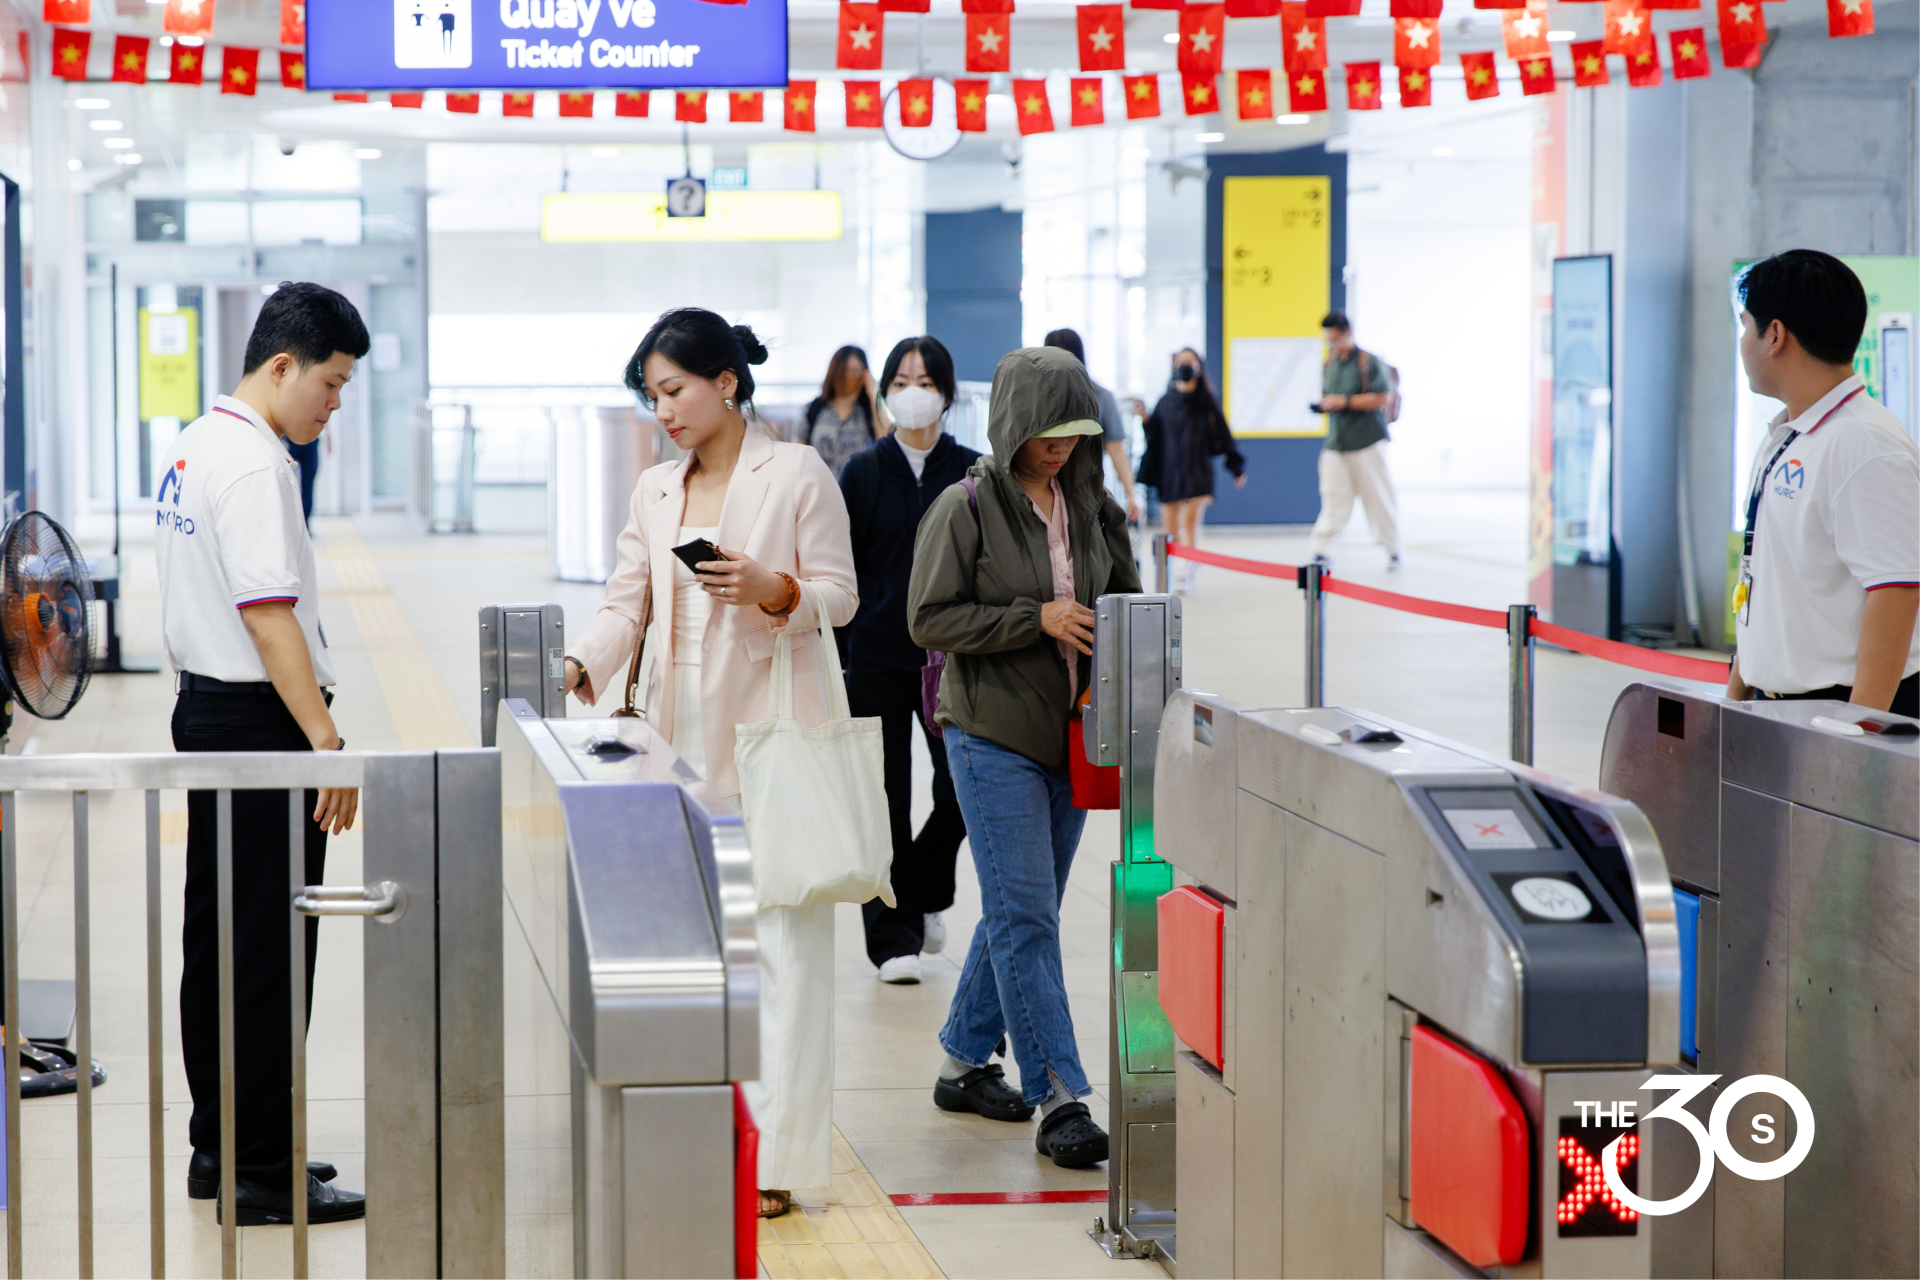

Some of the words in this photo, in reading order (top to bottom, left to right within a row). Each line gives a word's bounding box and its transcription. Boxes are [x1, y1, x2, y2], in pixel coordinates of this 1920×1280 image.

[500, 39, 584, 68] Ticket
[589, 38, 701, 68] Counter
[1773, 484, 1796, 500] HURC
[157, 509, 195, 535] MRO
